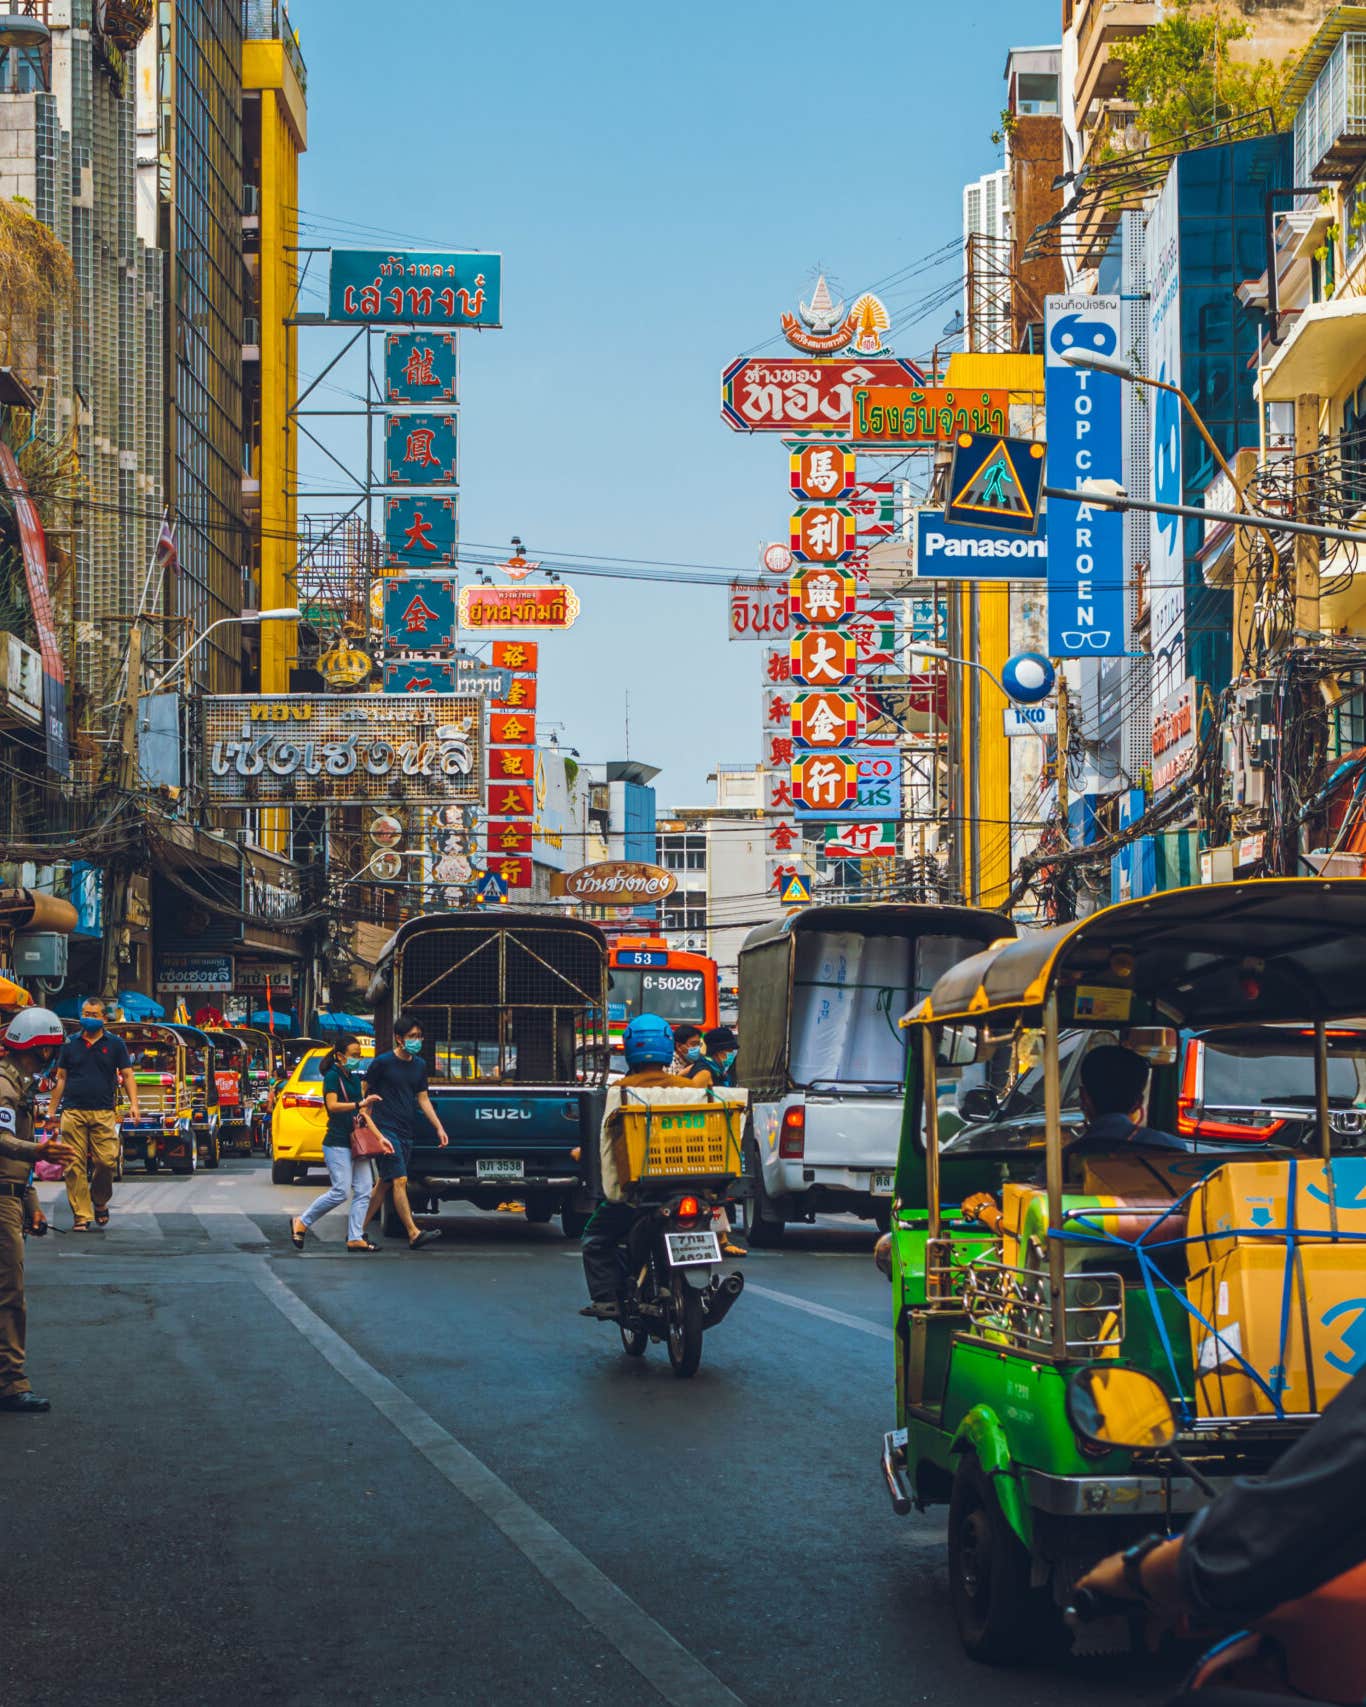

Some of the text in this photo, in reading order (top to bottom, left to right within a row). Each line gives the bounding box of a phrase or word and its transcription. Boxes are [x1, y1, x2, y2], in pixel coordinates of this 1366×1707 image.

[380, 256, 455, 277] ห้างทอง
[344, 273, 487, 318] เล่งหงษ์
[744, 365, 822, 383] ห้างทอง
[856, 390, 1004, 436] โรงรับจำนำ
[1075, 371, 1095, 626] TOP CAROEN
[926, 533, 1047, 558] Panasoni
[250, 704, 312, 721] ทอง
[634, 952, 652, 965] 53
[643, 976, 702, 991] 6-50267
[475, 1109, 532, 1120] ISUZU
